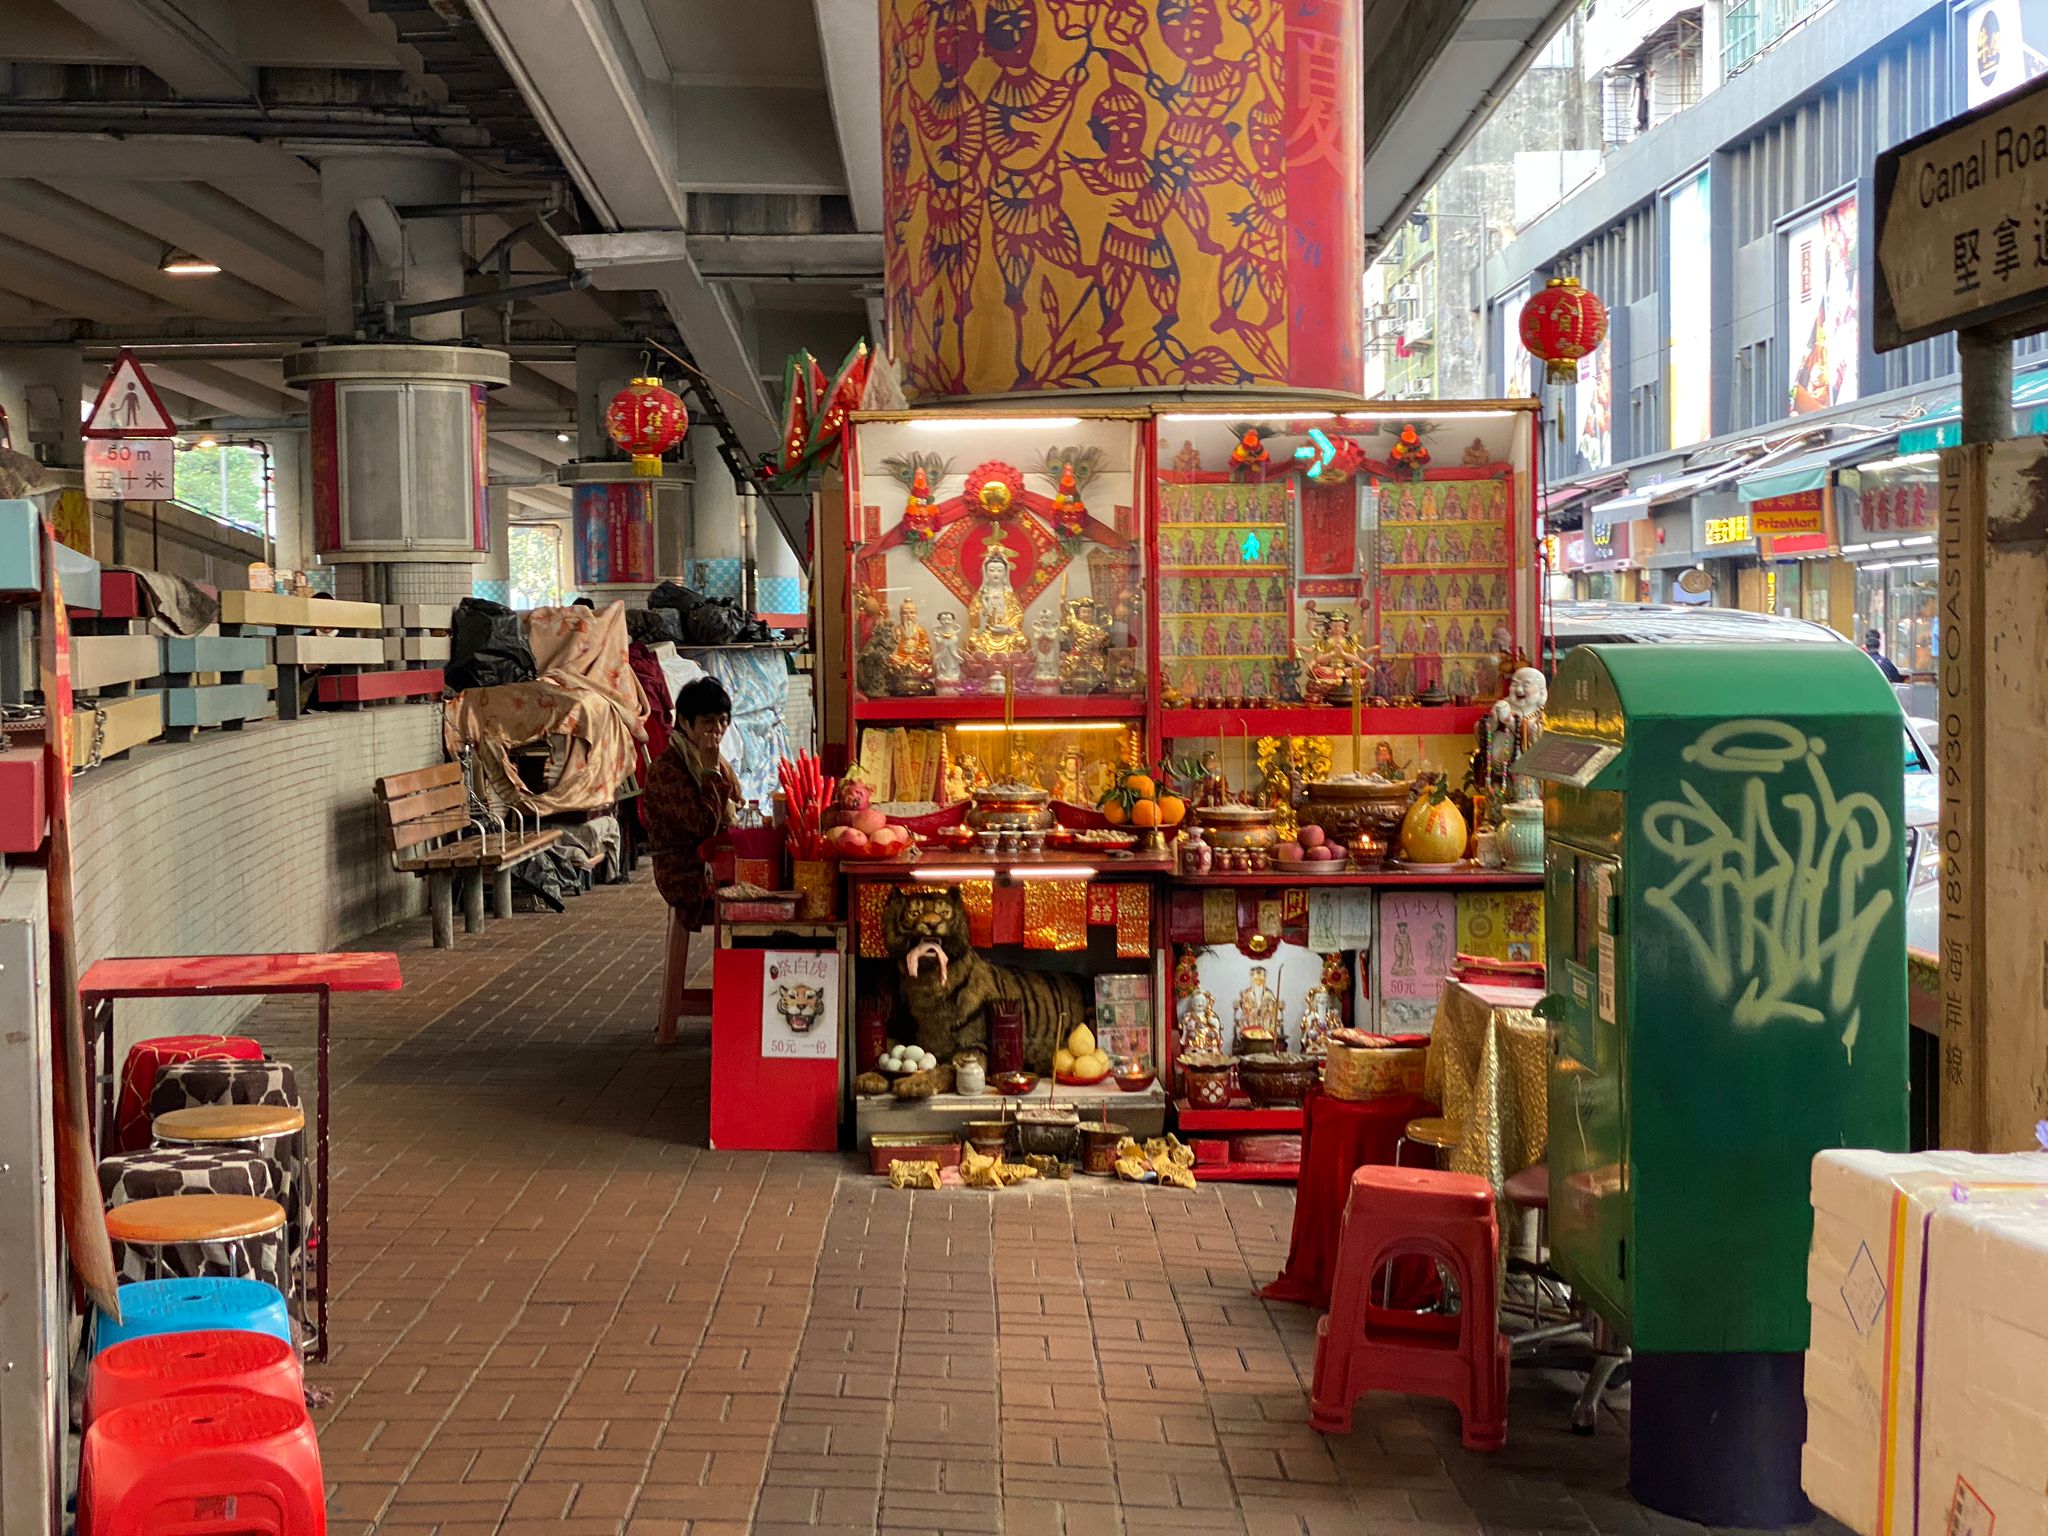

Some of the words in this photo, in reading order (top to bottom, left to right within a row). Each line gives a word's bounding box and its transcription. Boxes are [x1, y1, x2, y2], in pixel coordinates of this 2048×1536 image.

[1919, 139, 1987, 209] Canal
[107, 445, 131, 461] 50
[136, 450, 151, 461] m
[95, 470, 165, 490] 五十米
[1756, 516, 1819, 531] PrizeMart
[1945, 452, 1962, 698] COASTLINE
[1390, 979, 1416, 995] 50元
[771, 1039, 797, 1054] 50元
